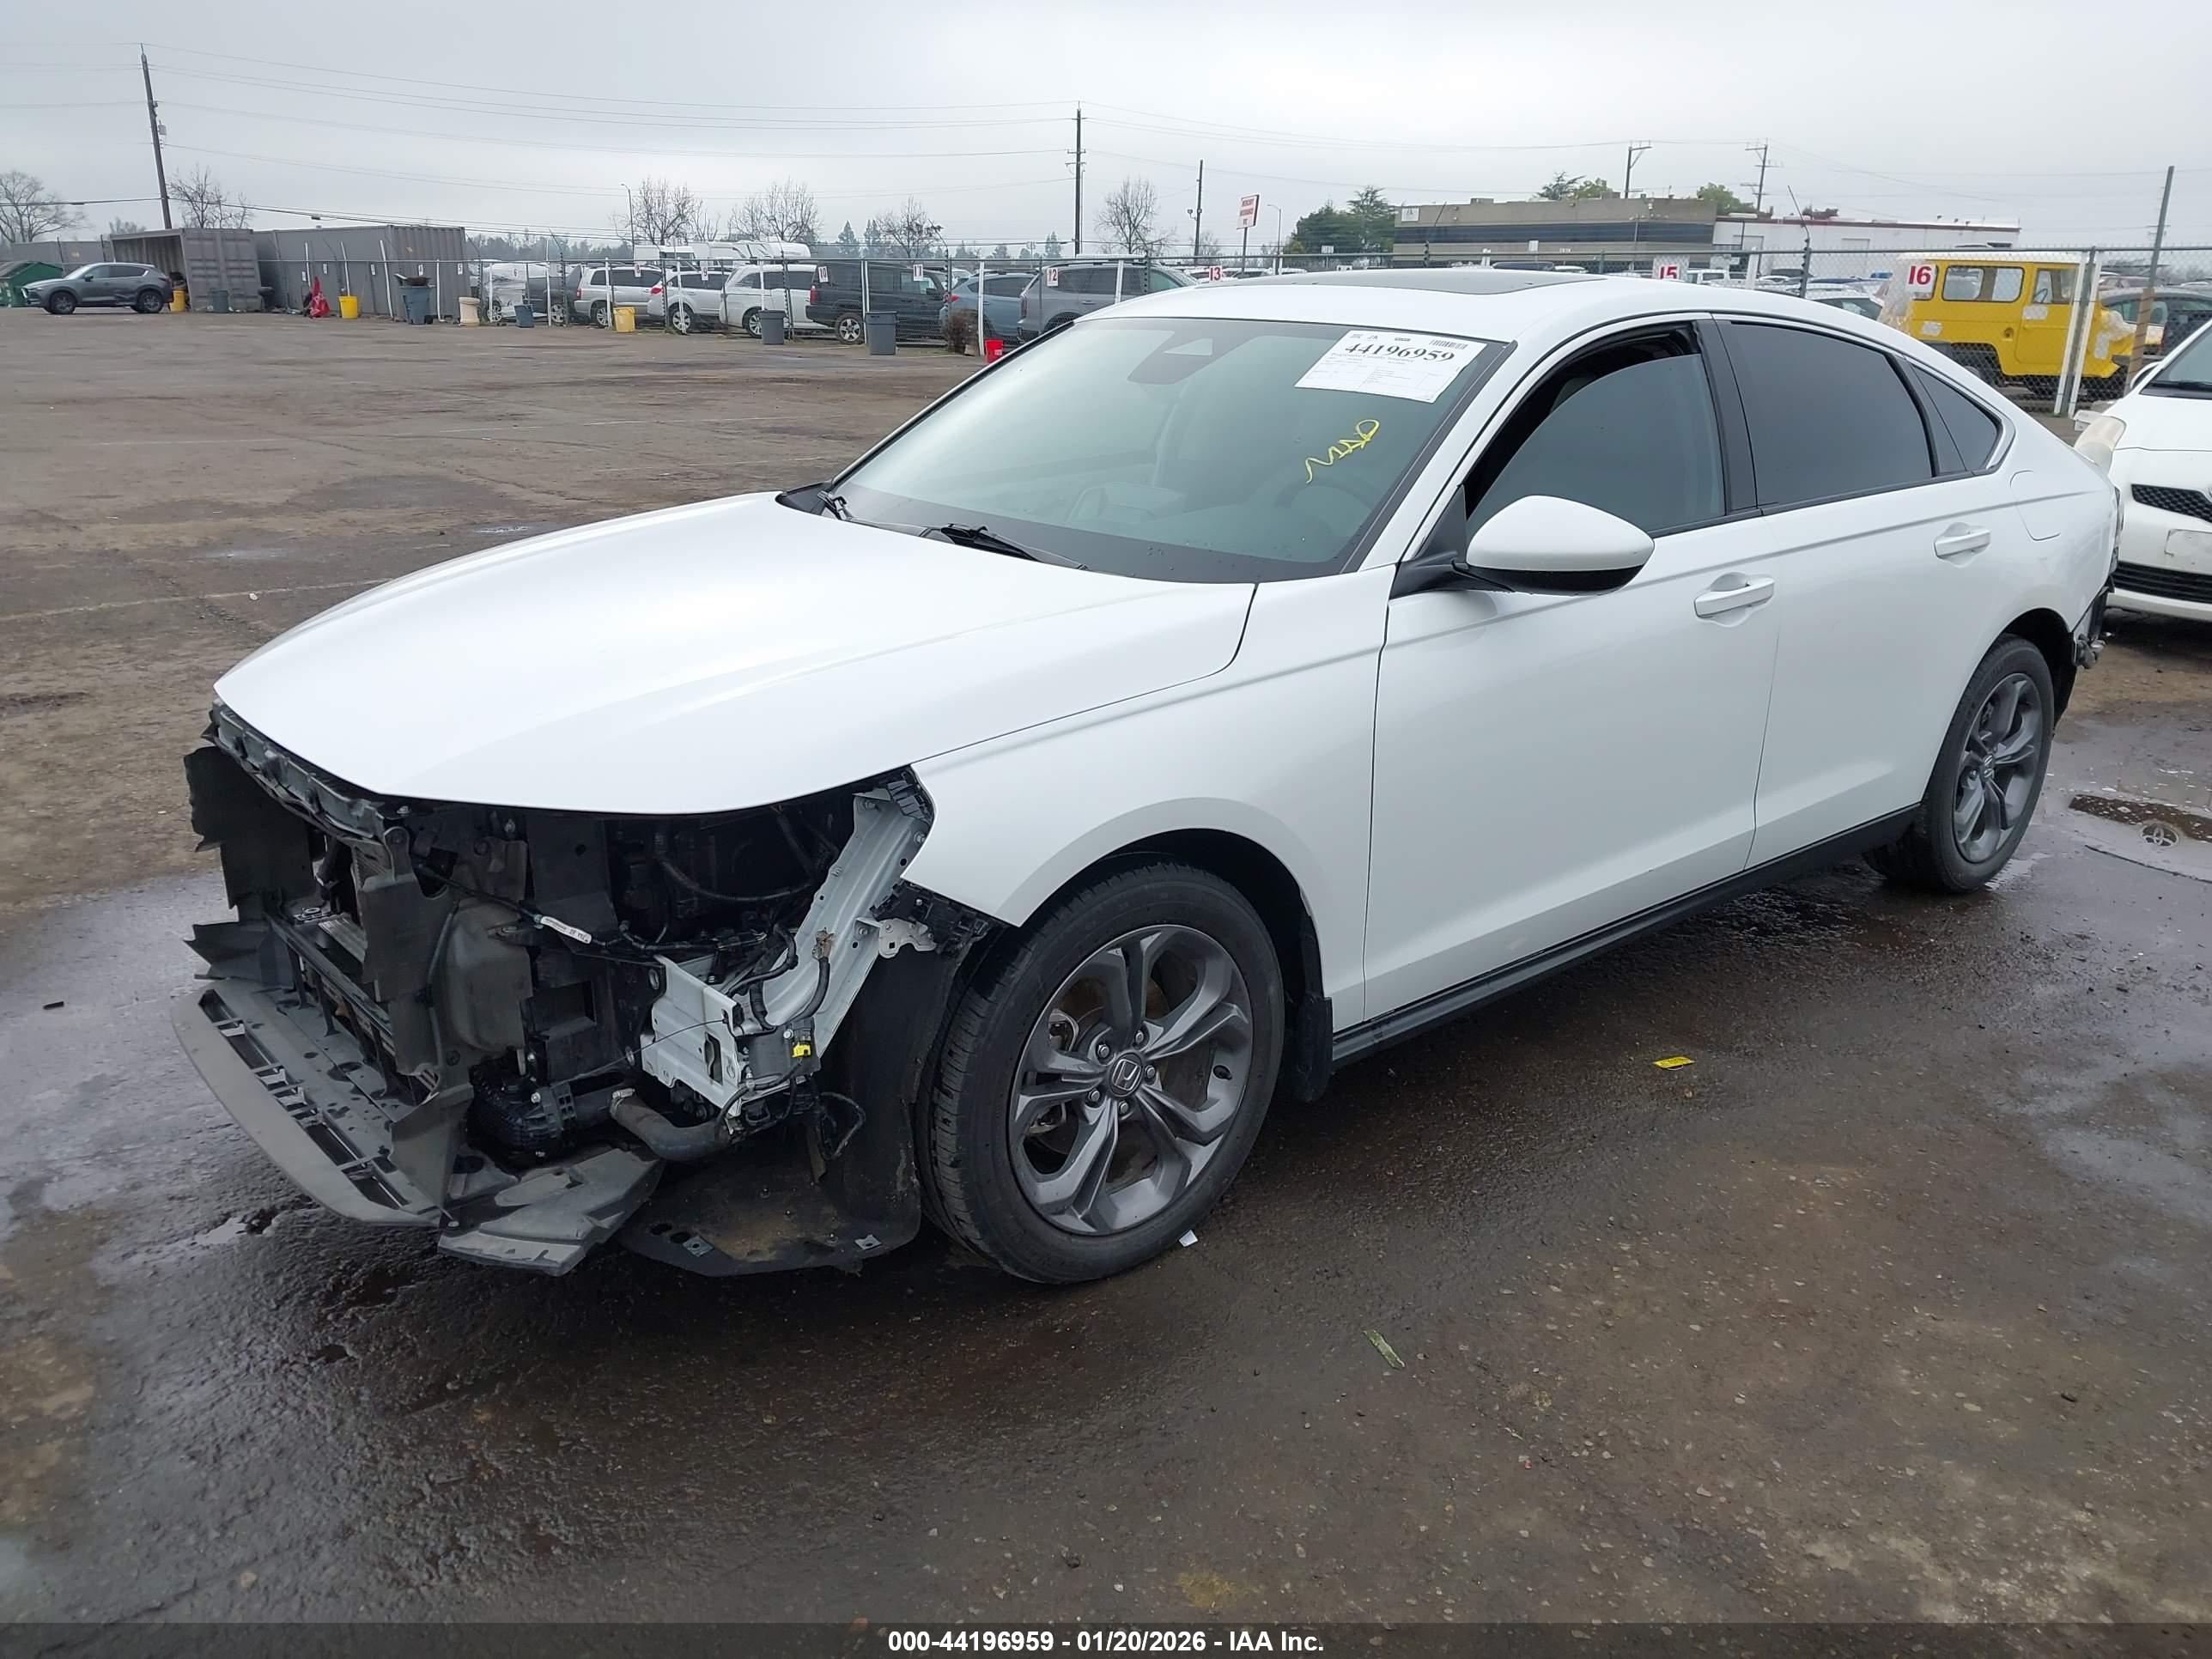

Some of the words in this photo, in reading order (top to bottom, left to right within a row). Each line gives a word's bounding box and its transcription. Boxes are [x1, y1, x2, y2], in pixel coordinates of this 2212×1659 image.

[1048, 268, 1058, 282] 12
[1210, 266, 1221, 282] 13
[1660, 266, 1678, 280] 15
[1908, 265, 1933, 285] 16
[1345, 343, 1455, 362] 44196959
